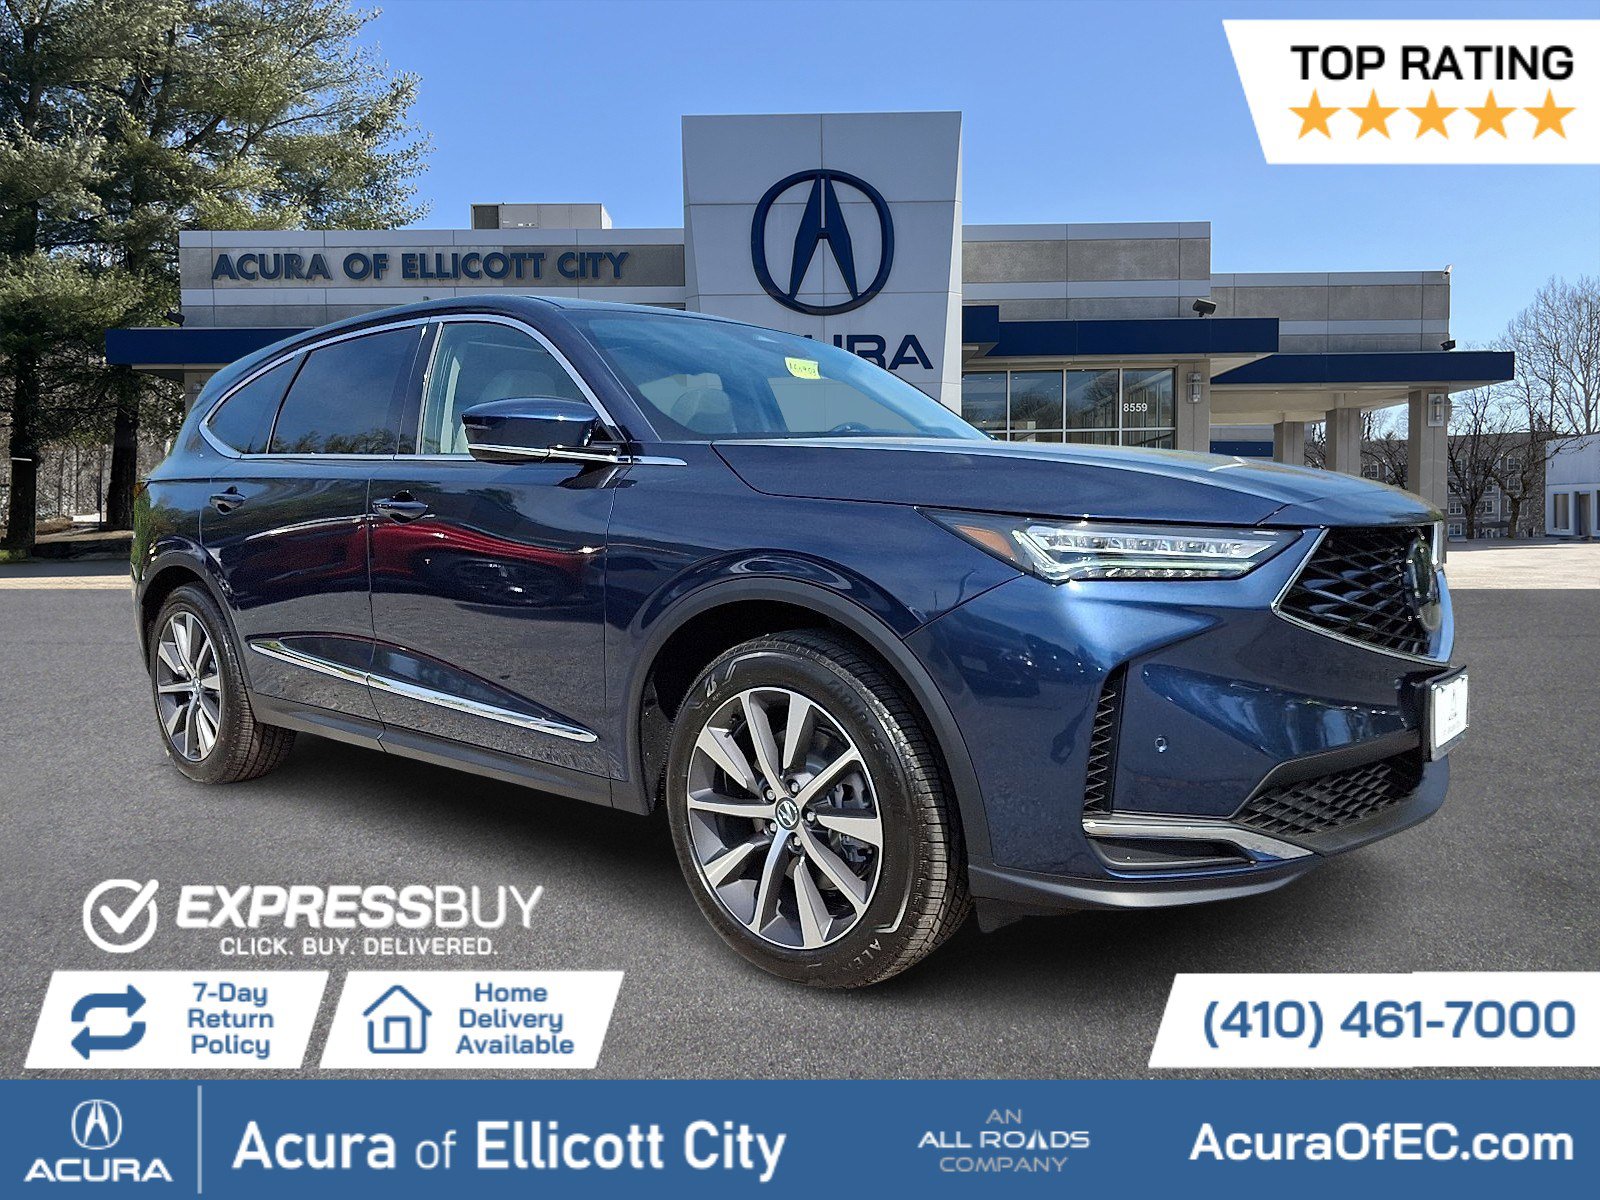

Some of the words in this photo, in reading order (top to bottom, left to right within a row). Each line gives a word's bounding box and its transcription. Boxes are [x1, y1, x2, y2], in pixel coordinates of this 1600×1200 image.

[211, 253, 333, 281] ACURA
[343, 252, 390, 280] OF
[401, 252, 546, 280] ELLICOTT
[557, 251, 629, 279] CITY
[1123, 402, 1148, 412] 8559
